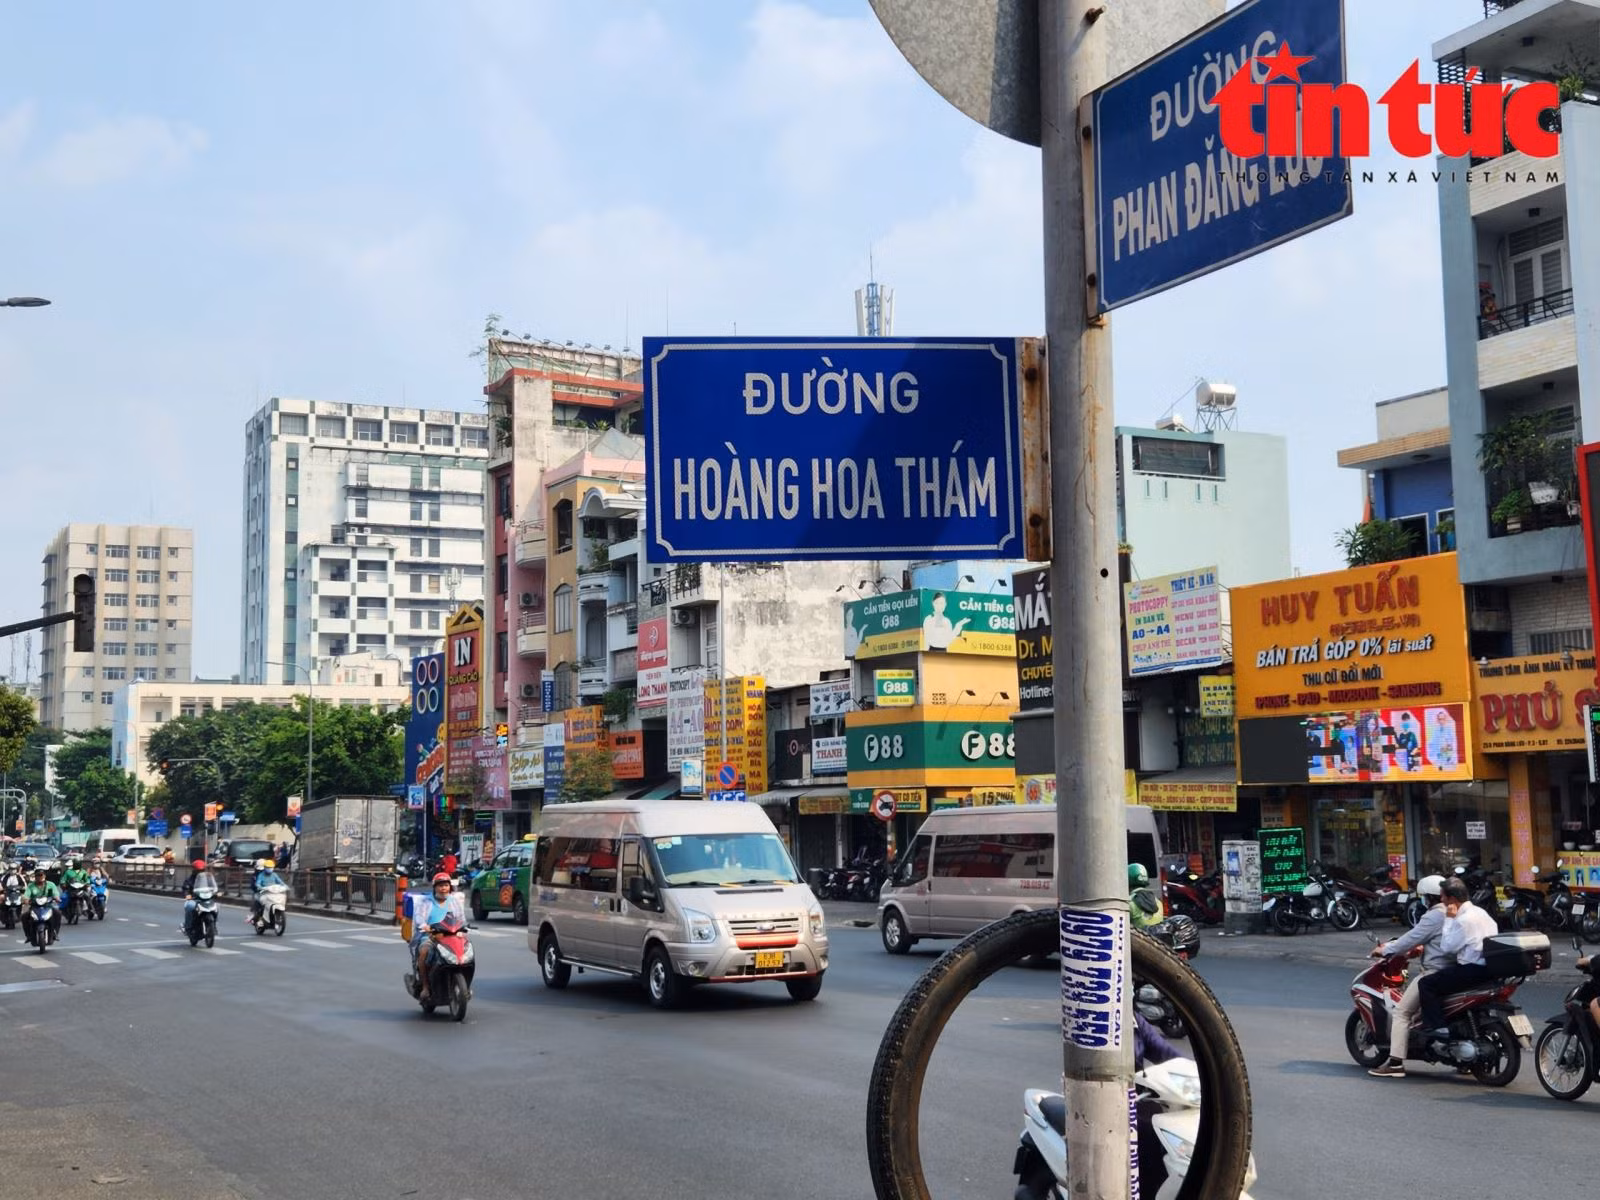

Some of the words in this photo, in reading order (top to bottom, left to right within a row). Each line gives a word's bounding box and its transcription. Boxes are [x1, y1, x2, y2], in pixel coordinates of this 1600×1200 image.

[1112, 176, 1179, 261] PHAN
[743, 357, 919, 415] ĐƯỜNG
[673, 441, 800, 520] HOÀNG
[811, 458, 885, 519] HOA
[895, 440, 997, 518] THÁM
[959, 598, 981, 611] CẦN
[983, 597, 1003, 612] TIỀN
[1014, 572, 1053, 632] MẮ
[1260, 590, 1319, 627] HUY
[1334, 565, 1420, 617] TUẤN
[882, 614, 899, 629] F88
[1157, 624, 1170, 635] A4
[454, 637, 472, 666] IN
[979, 642, 995, 651] 1800
[1018, 639, 1038, 660] Dr.
[1256, 644, 1287, 669] BÁN
[1291, 635, 1318, 664] TRẢ
[1324, 637, 1354, 662] GÓP
[1359, 635, 1385, 657] 0%
[1386, 638, 1402, 655] lãi
[1404, 633, 1434, 652] suất
[1021, 663, 1054, 682] CHUYÊ
[1523, 661, 1540, 673] ẢNH
[883, 680, 909, 694] F88
[1303, 672, 1324, 687] THU
[1020, 686, 1054, 701] Hotline:
[1255, 694, 1290, 709] IPHONE
[1297, 692, 1321, 706] IPAD
[1388, 682, 1441, 698] SAMSUNG
[816, 748, 842, 759] THANH
[864, 734, 904, 762] F88
[961, 730, 1015, 760] F88
[982, 792, 994, 804] 15
[1060, 910, 1113, 962] 0979
